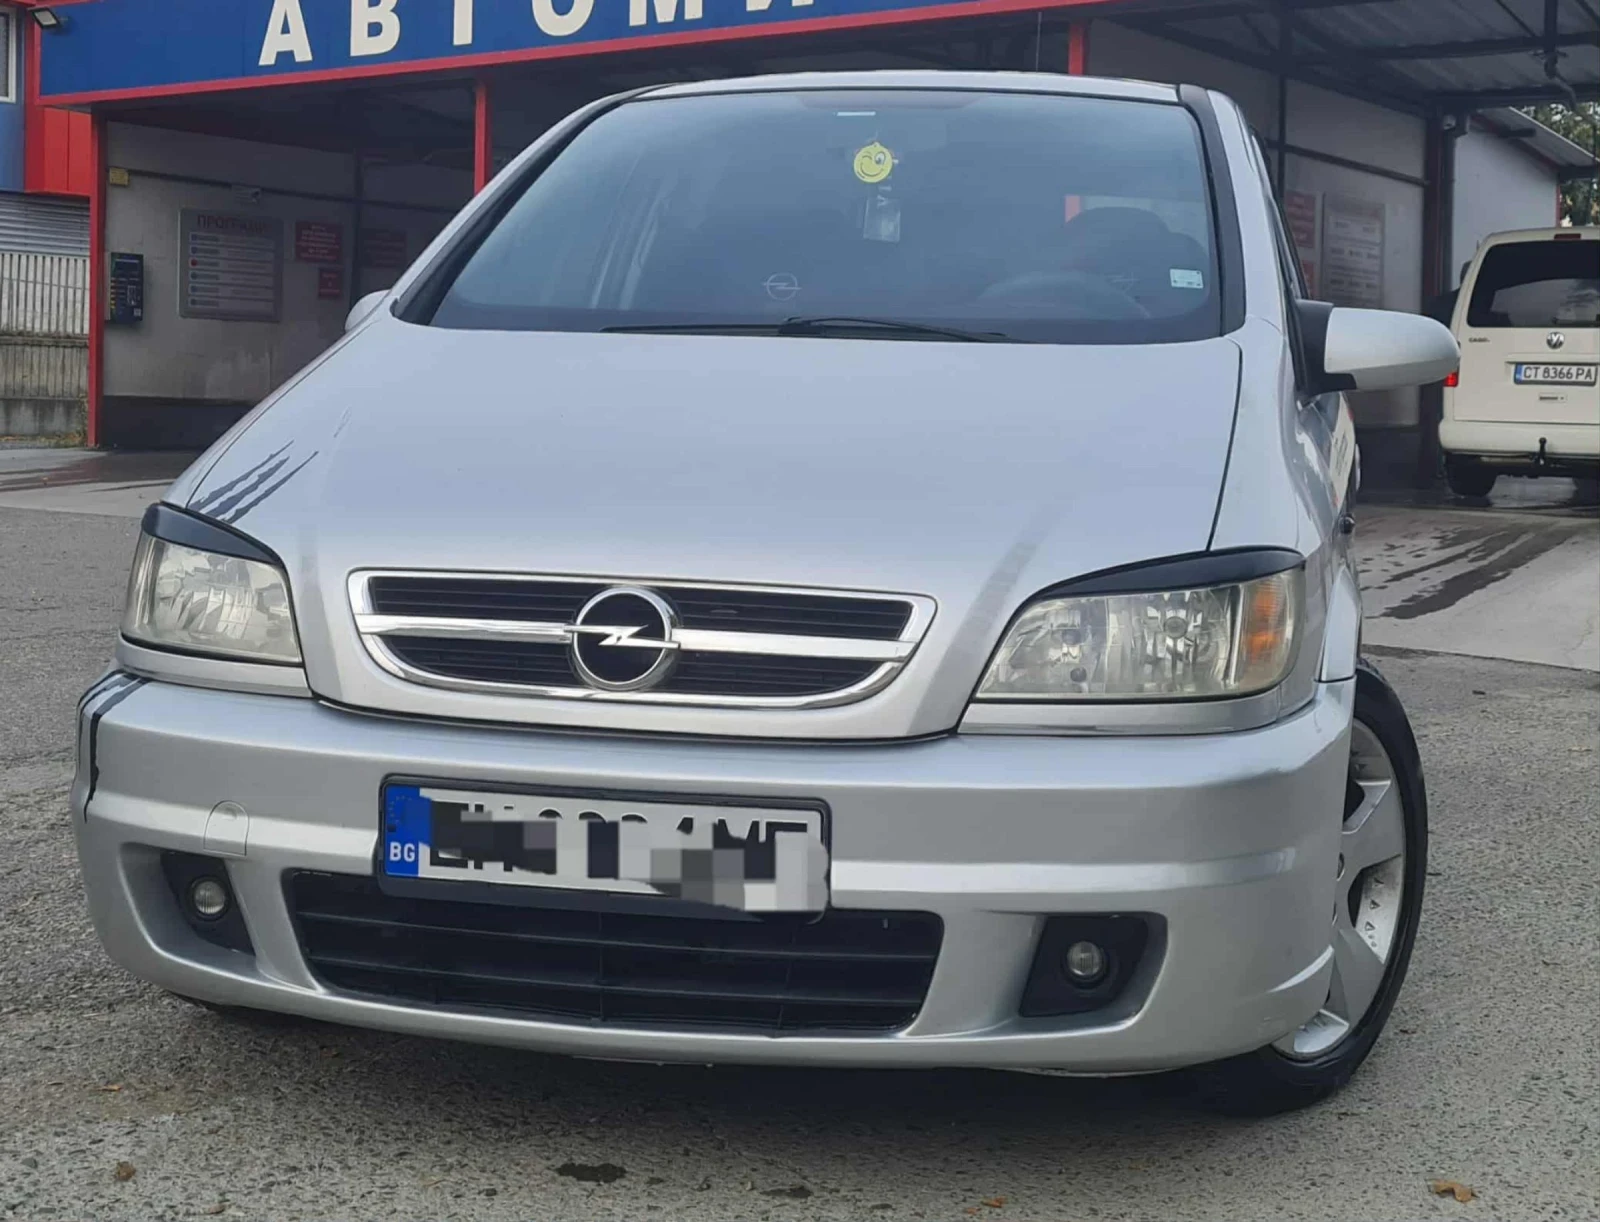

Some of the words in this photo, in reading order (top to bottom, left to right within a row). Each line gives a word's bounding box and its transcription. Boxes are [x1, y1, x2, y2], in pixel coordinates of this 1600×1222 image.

[1523, 366, 1541, 379] CT
[1542, 366, 1574, 380] 8366
[1575, 367, 1592, 380] PA
[389, 841, 416, 862] BG
